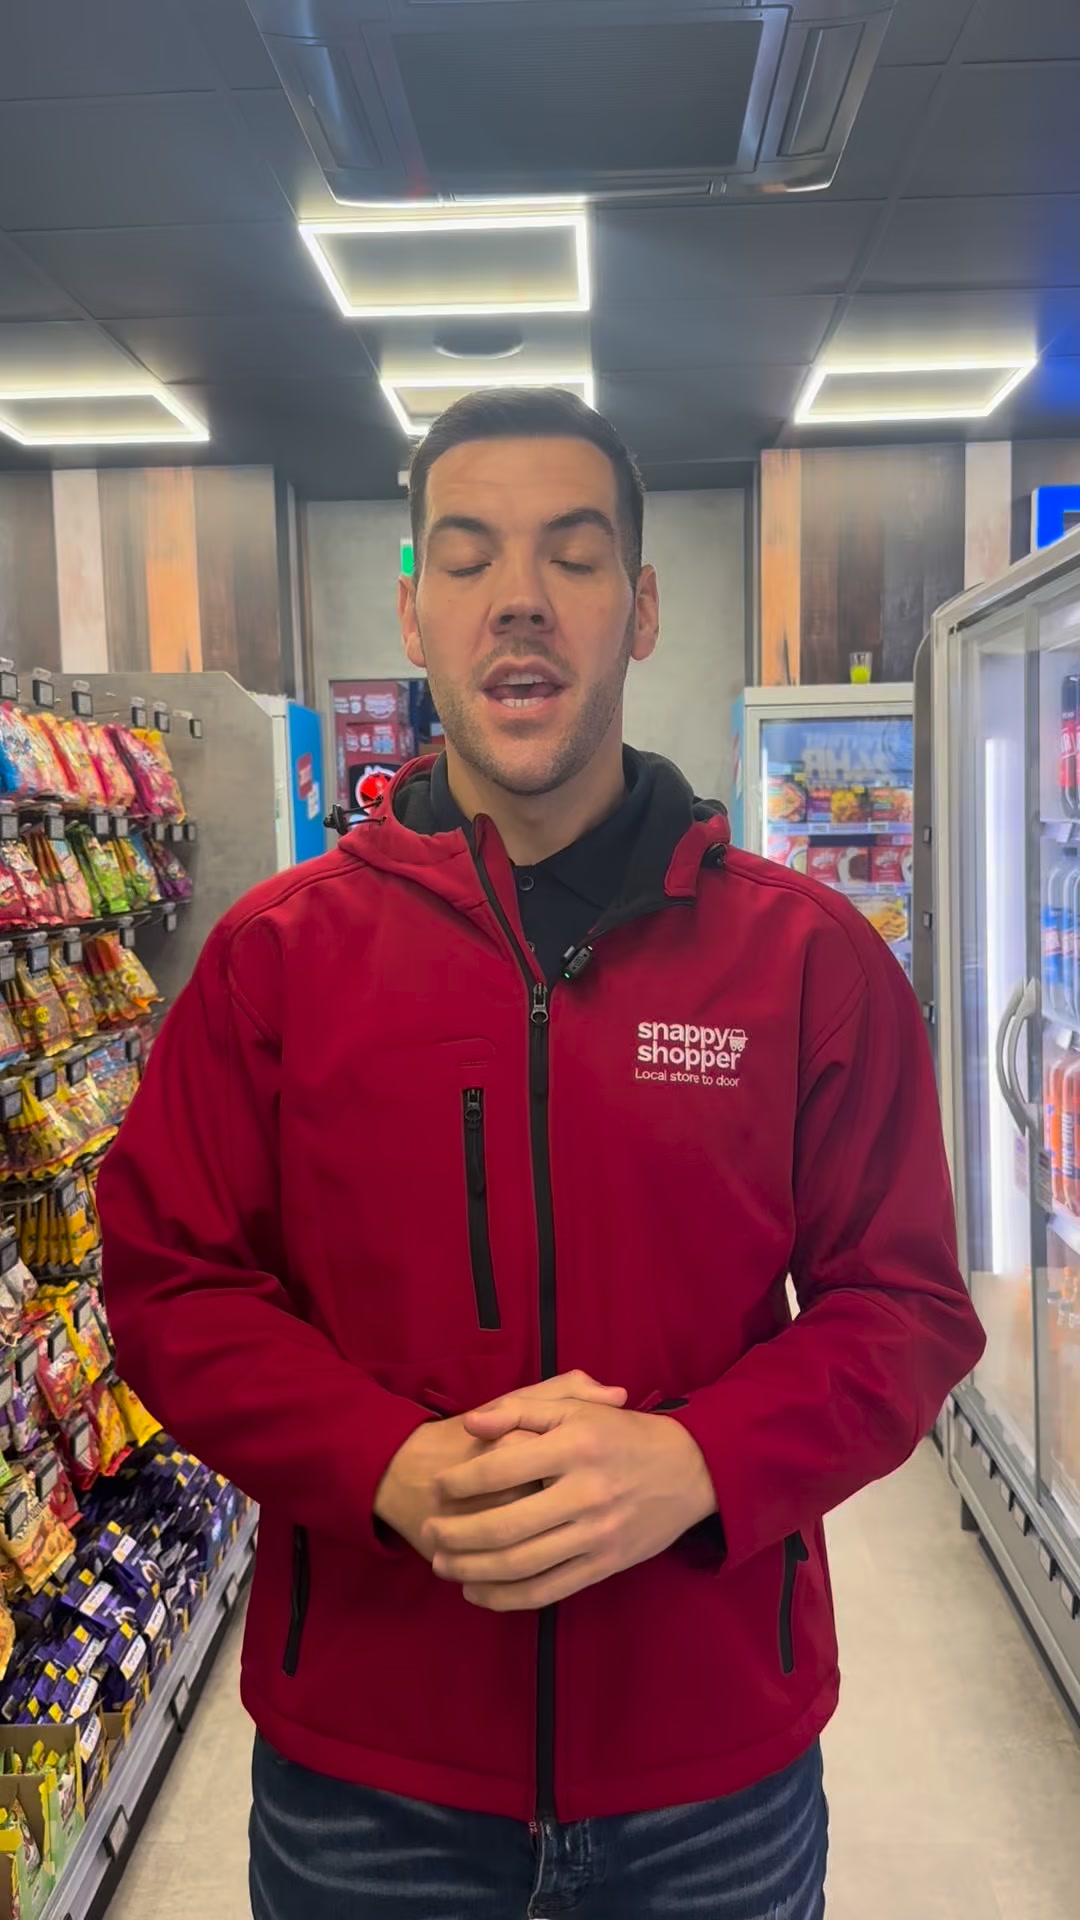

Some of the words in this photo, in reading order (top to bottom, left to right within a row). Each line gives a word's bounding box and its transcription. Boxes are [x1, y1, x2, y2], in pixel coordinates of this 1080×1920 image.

[637, 1021, 731, 1051] snappy
[637, 1041, 741, 1073] shopper
[634, 1067, 667, 1081] Local
[669, 1071, 700, 1084] store
[702, 1074, 714, 1086] to
[716, 1075, 741, 1087] door
